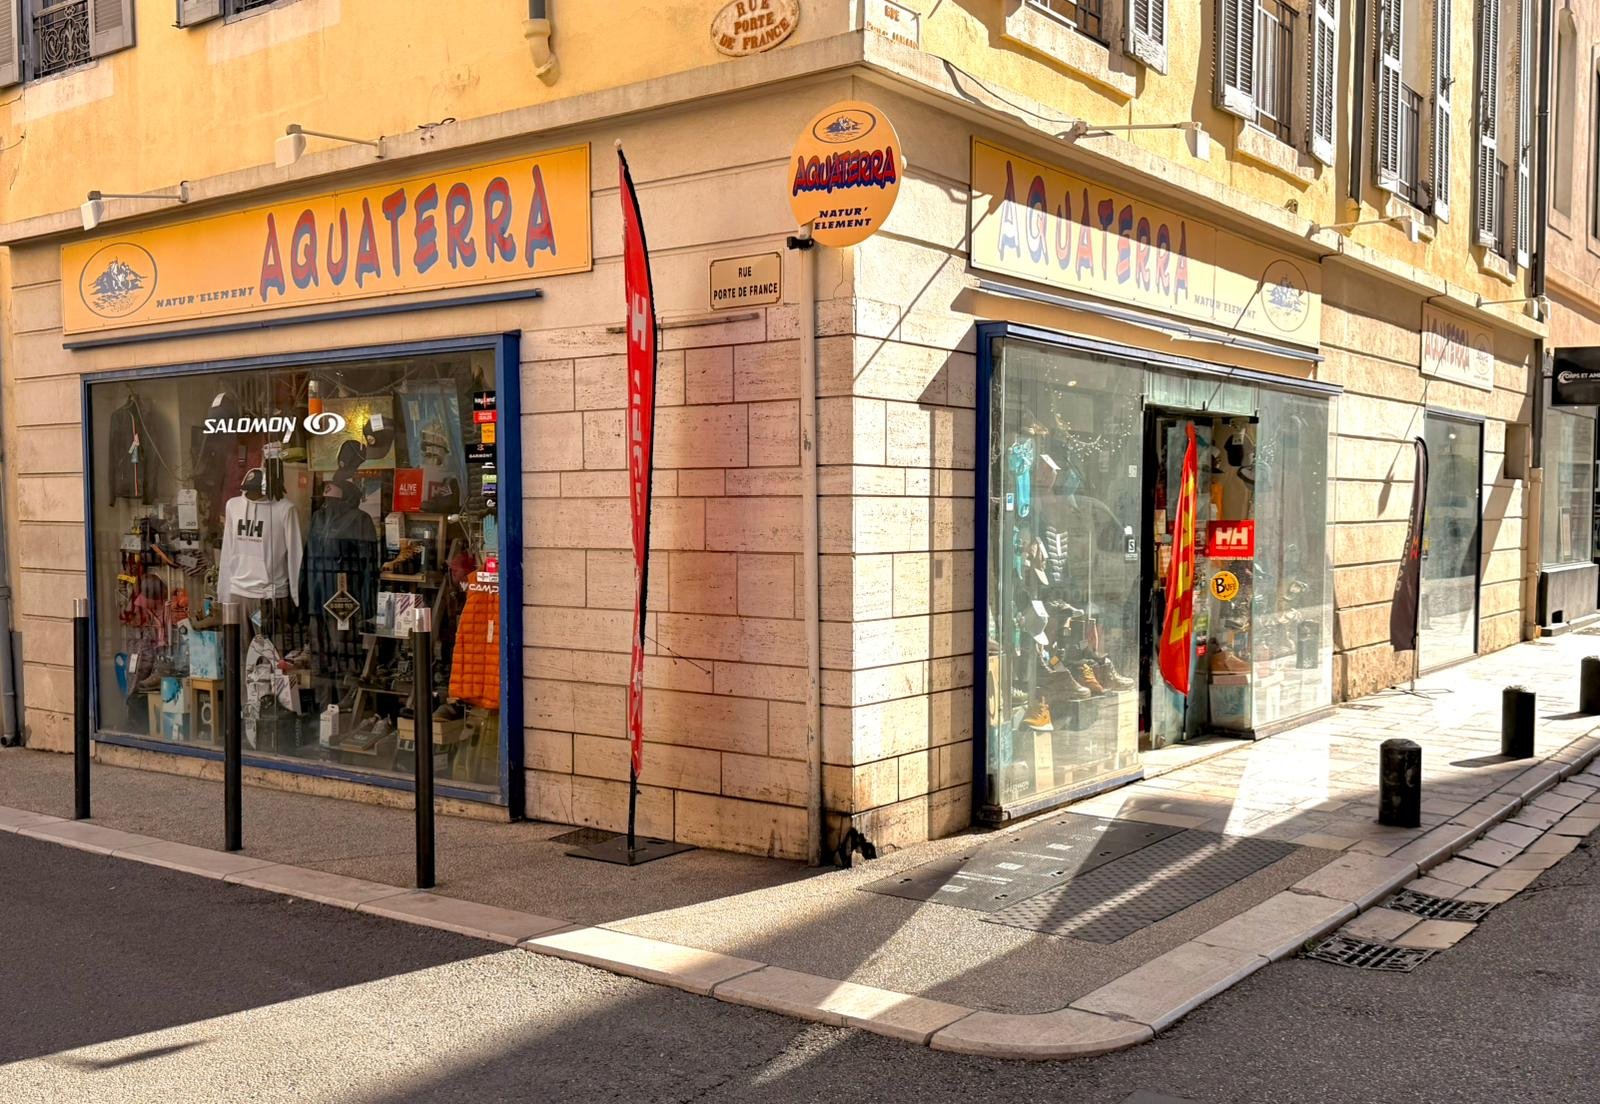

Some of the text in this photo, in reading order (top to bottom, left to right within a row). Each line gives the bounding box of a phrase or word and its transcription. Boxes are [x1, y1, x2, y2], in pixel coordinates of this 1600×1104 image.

[736, 0, 770, 17] RUE
[734, 11, 775, 35] PORTE
[719, 17, 790, 50] DE FRANCE
[792, 145, 897, 197] AQUATERRA
[819, 206, 869, 219] NATUR'
[259, 164, 557, 303] AQUATERRA
[814, 217, 872, 231] ELEMENT
[997, 160, 1190, 304] AQUATERRA
[738, 266, 752, 278] RUE
[713, 281, 778, 301] PORTE DE FRANCE
[203, 416, 296, 443] SALOMON
[399, 483, 417, 491] ALIVE
[237, 518, 264, 537] HH
[1215, 527, 1249, 545] HH
[468, 583, 500, 595] CAMP
